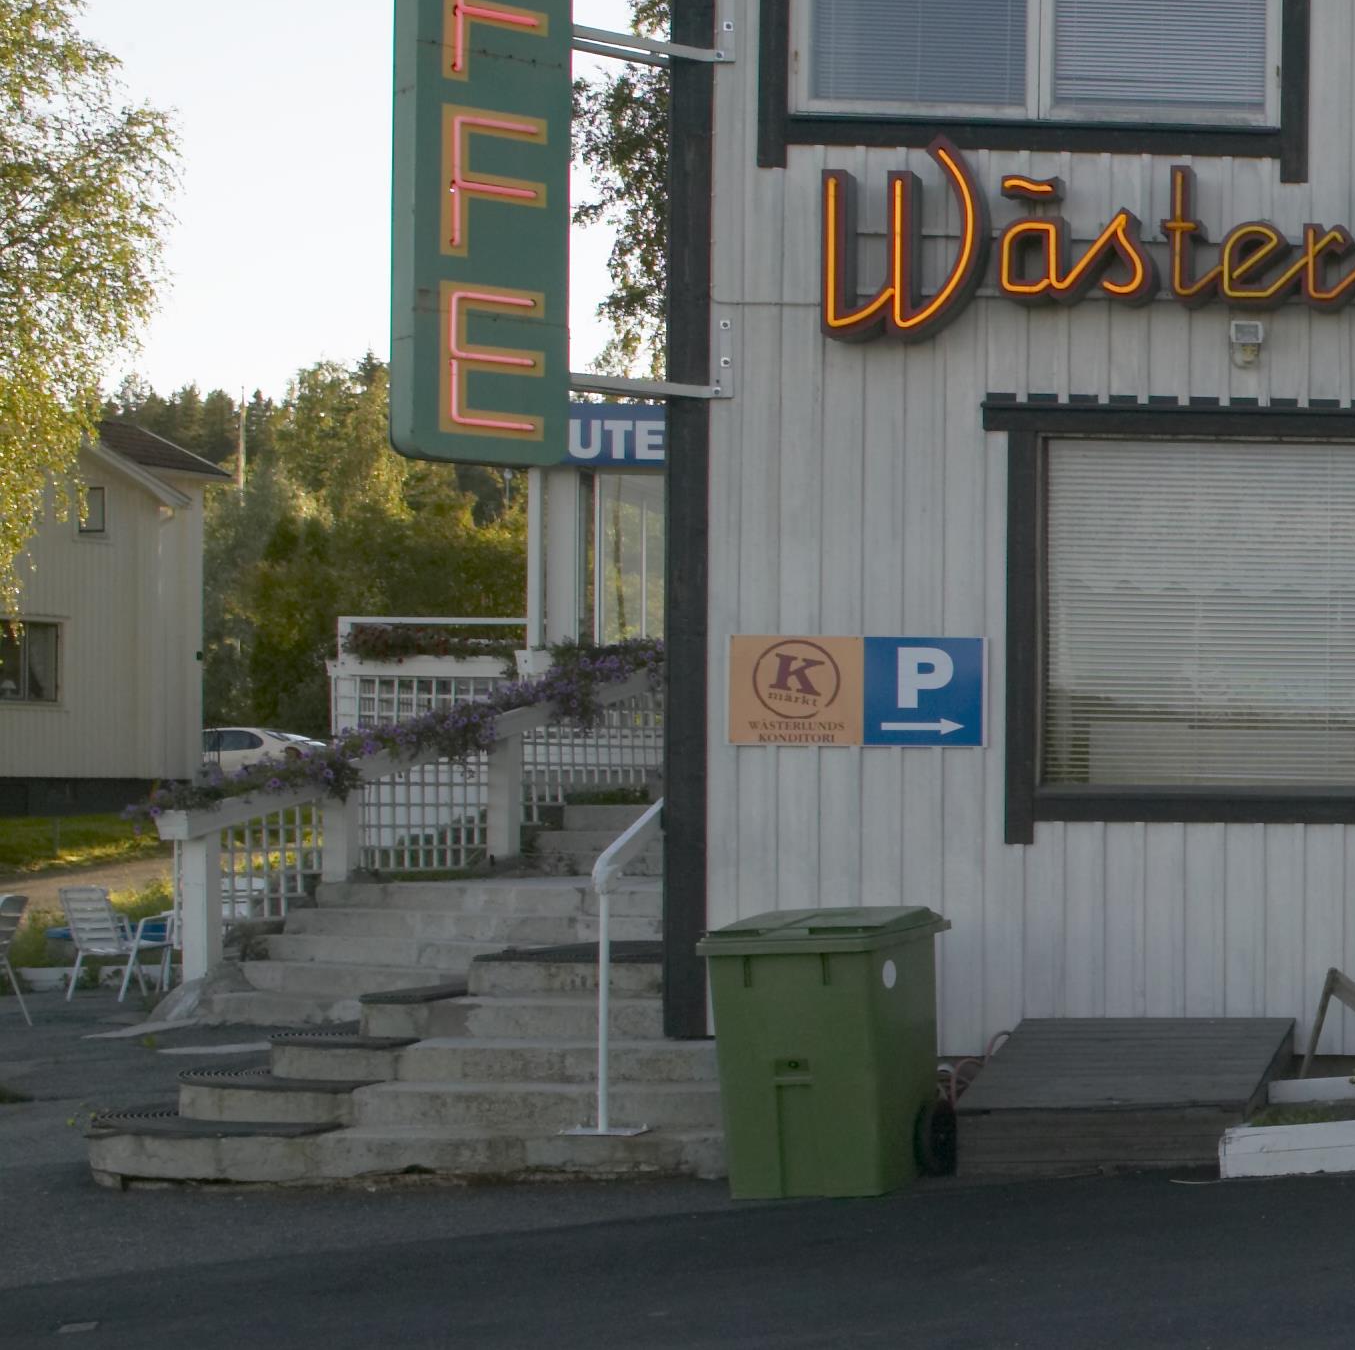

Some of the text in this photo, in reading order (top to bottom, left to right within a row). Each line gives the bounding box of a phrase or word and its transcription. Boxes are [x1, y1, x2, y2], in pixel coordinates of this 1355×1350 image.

[768, 653, 825, 697] K
[898, 647, 954, 708] P
[758, 733, 836, 744] KONDITORI
